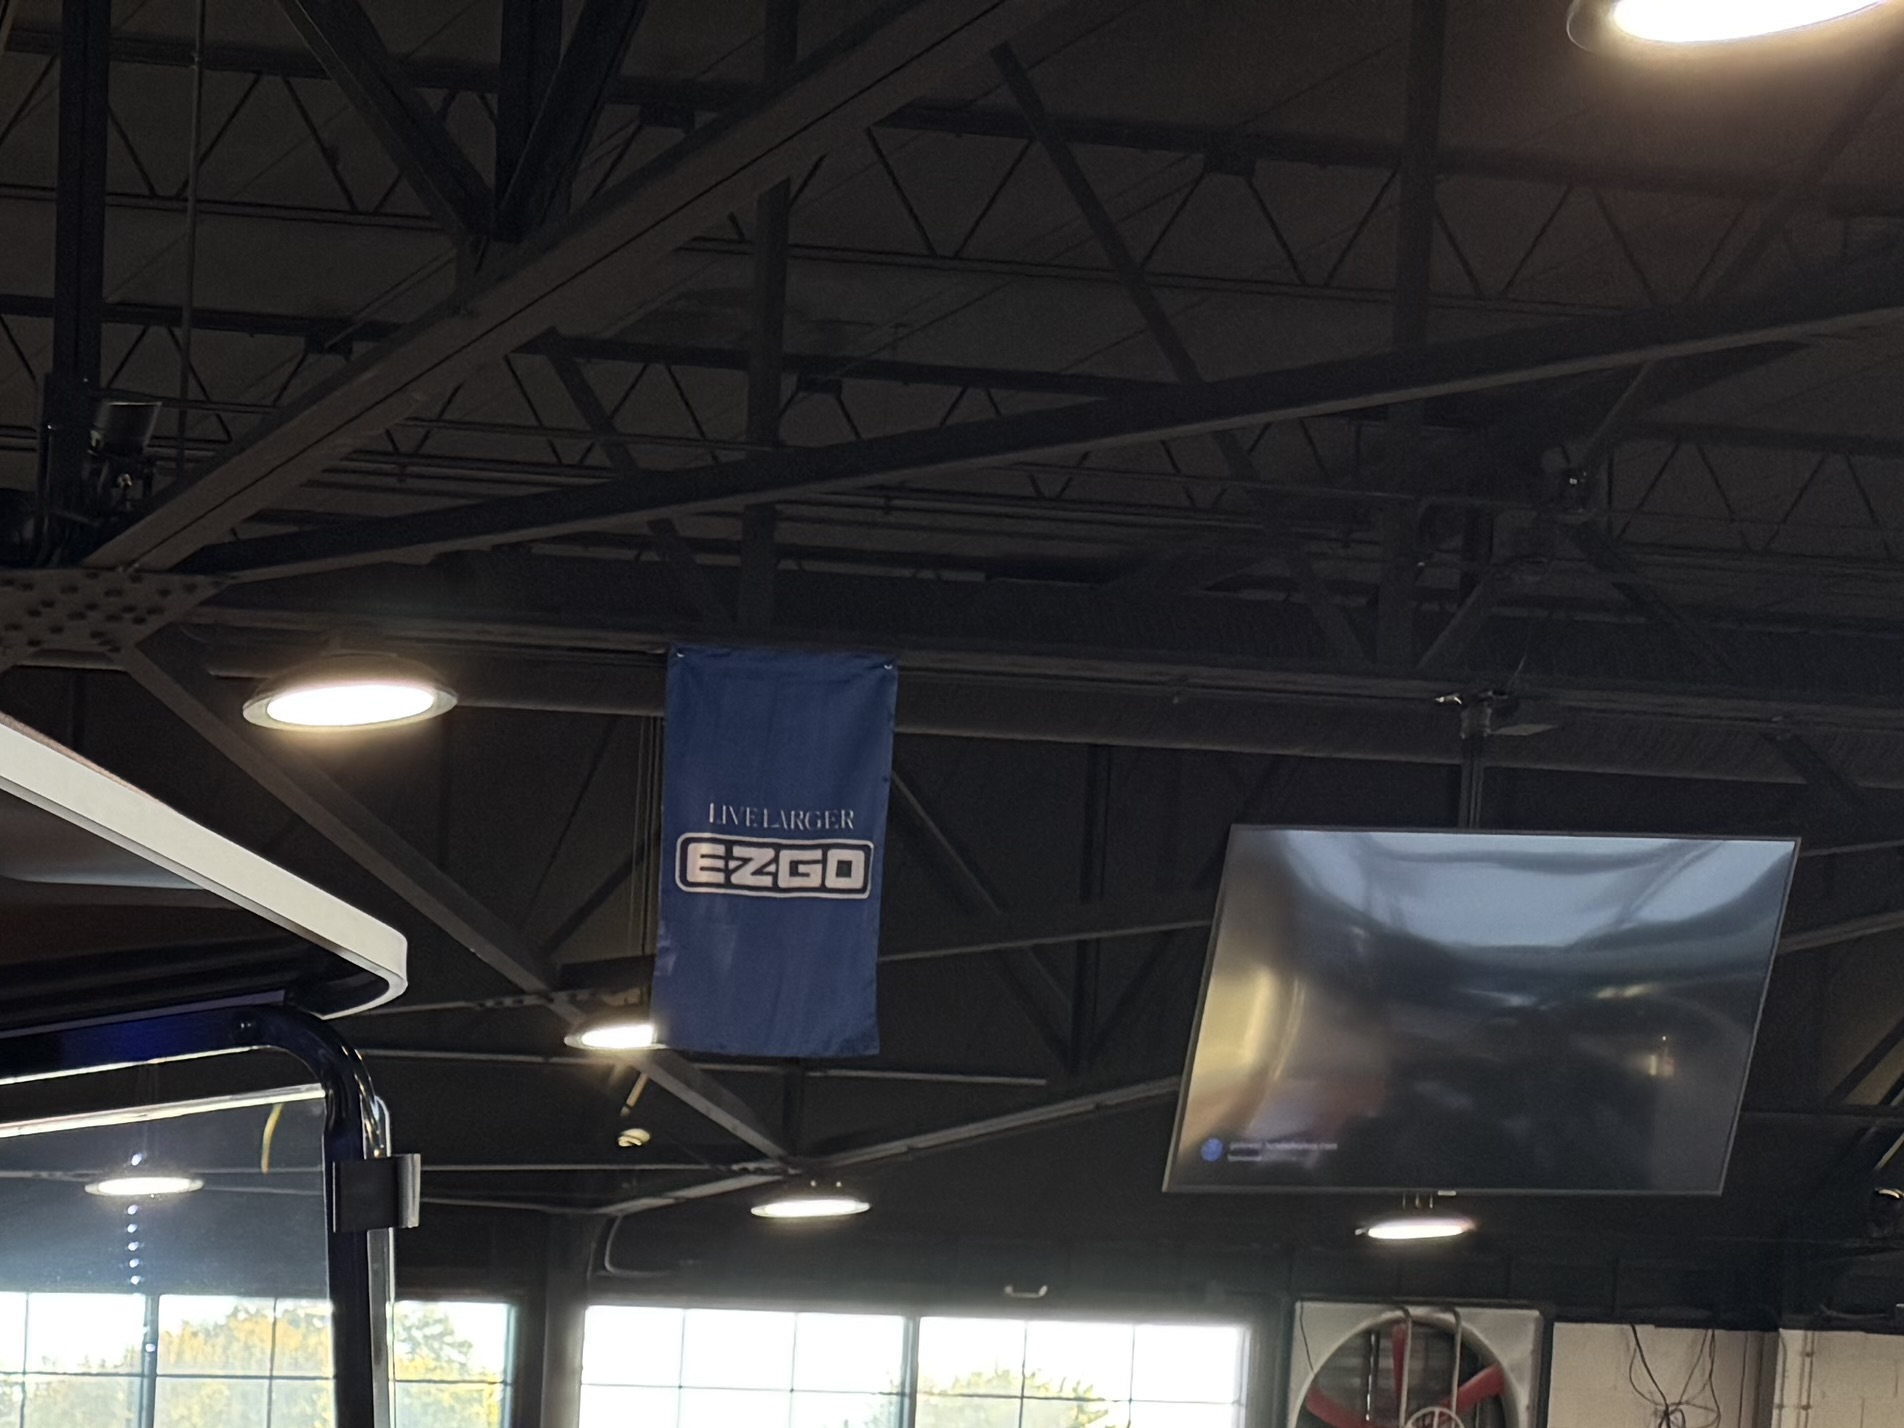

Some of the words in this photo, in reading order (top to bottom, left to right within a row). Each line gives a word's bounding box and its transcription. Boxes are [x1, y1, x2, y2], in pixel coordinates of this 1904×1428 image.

[709, 802, 758, 828] LIVE
[763, 808, 855, 831] LARGER
[686, 842, 866, 889] EZGO
